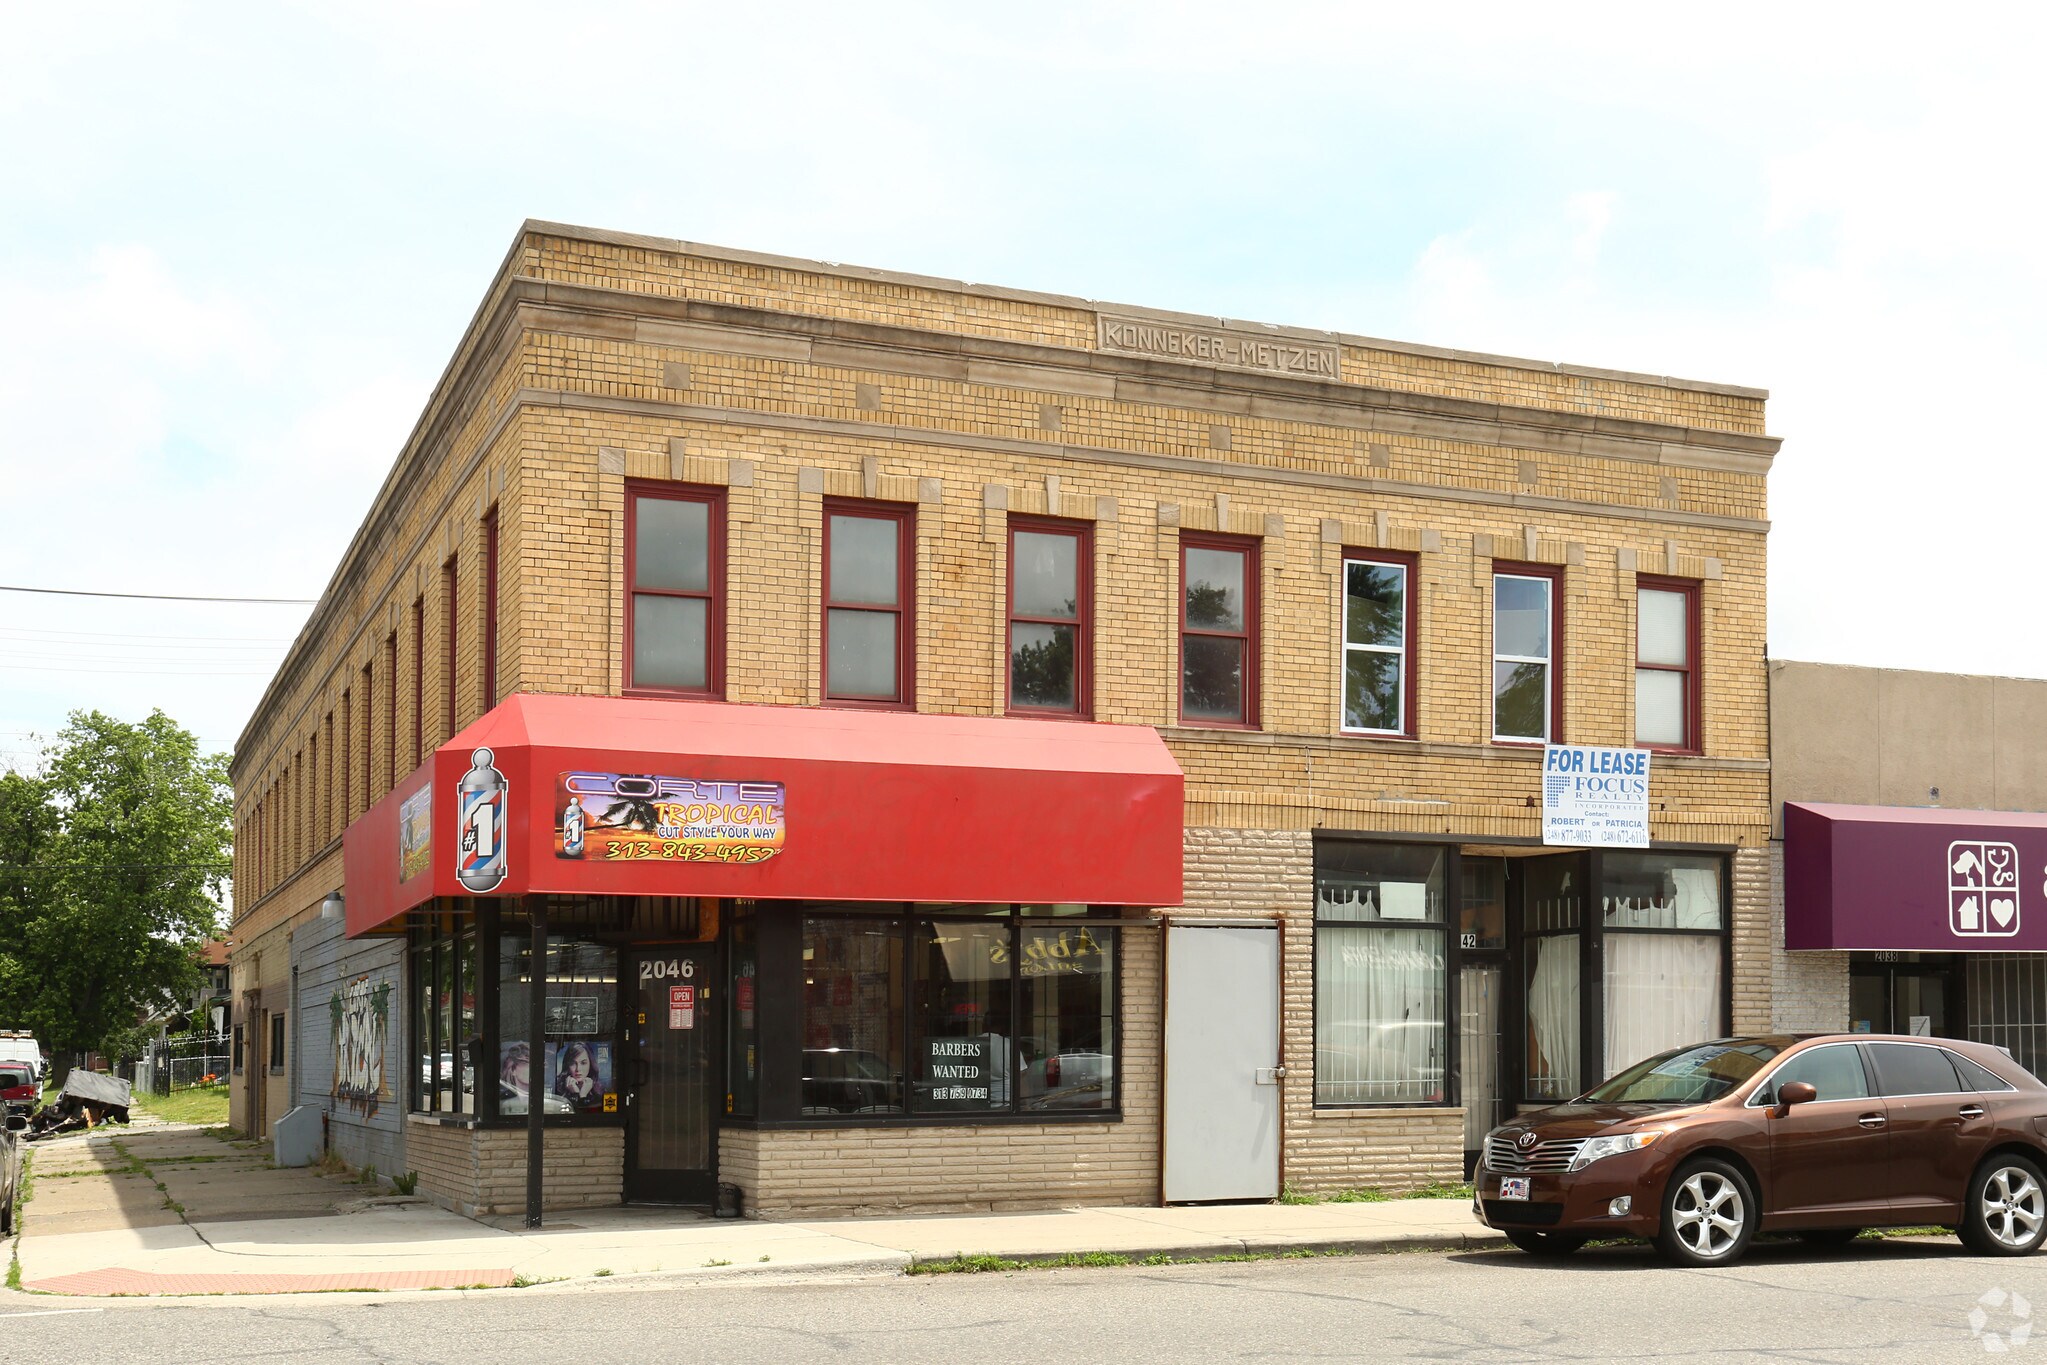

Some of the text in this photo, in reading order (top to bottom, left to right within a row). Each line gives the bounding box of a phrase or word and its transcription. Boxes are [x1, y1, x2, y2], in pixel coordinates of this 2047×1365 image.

[1104, 322, 1333, 374] KONNEKER-METZEN
[1547, 749, 1646, 775] FOR LEASE
[565, 775, 778, 802] CORTE
[1575, 776, 1645, 793] FOCUS
[1575, 792, 1644, 801] REALTY
[653, 803, 778, 825] TROPICAL
[1575, 803, 1644, 811] INCORPORATED
[462, 802, 495, 857] #1
[1551, 817, 1585, 826] ROBERT
[1605, 820, 1643, 828] PATRICIA
[658, 826, 777, 839] CUT STYLE YOUR WAY
[1876, 951, 1898, 962] 2038
[640, 959, 694, 979] 2046
[673, 991, 690, 1001] OPEN
[931, 1043, 981, 1057] BARBERS
[932, 1065, 979, 1079] WANTED
[933, 1087, 948, 1099] 313
